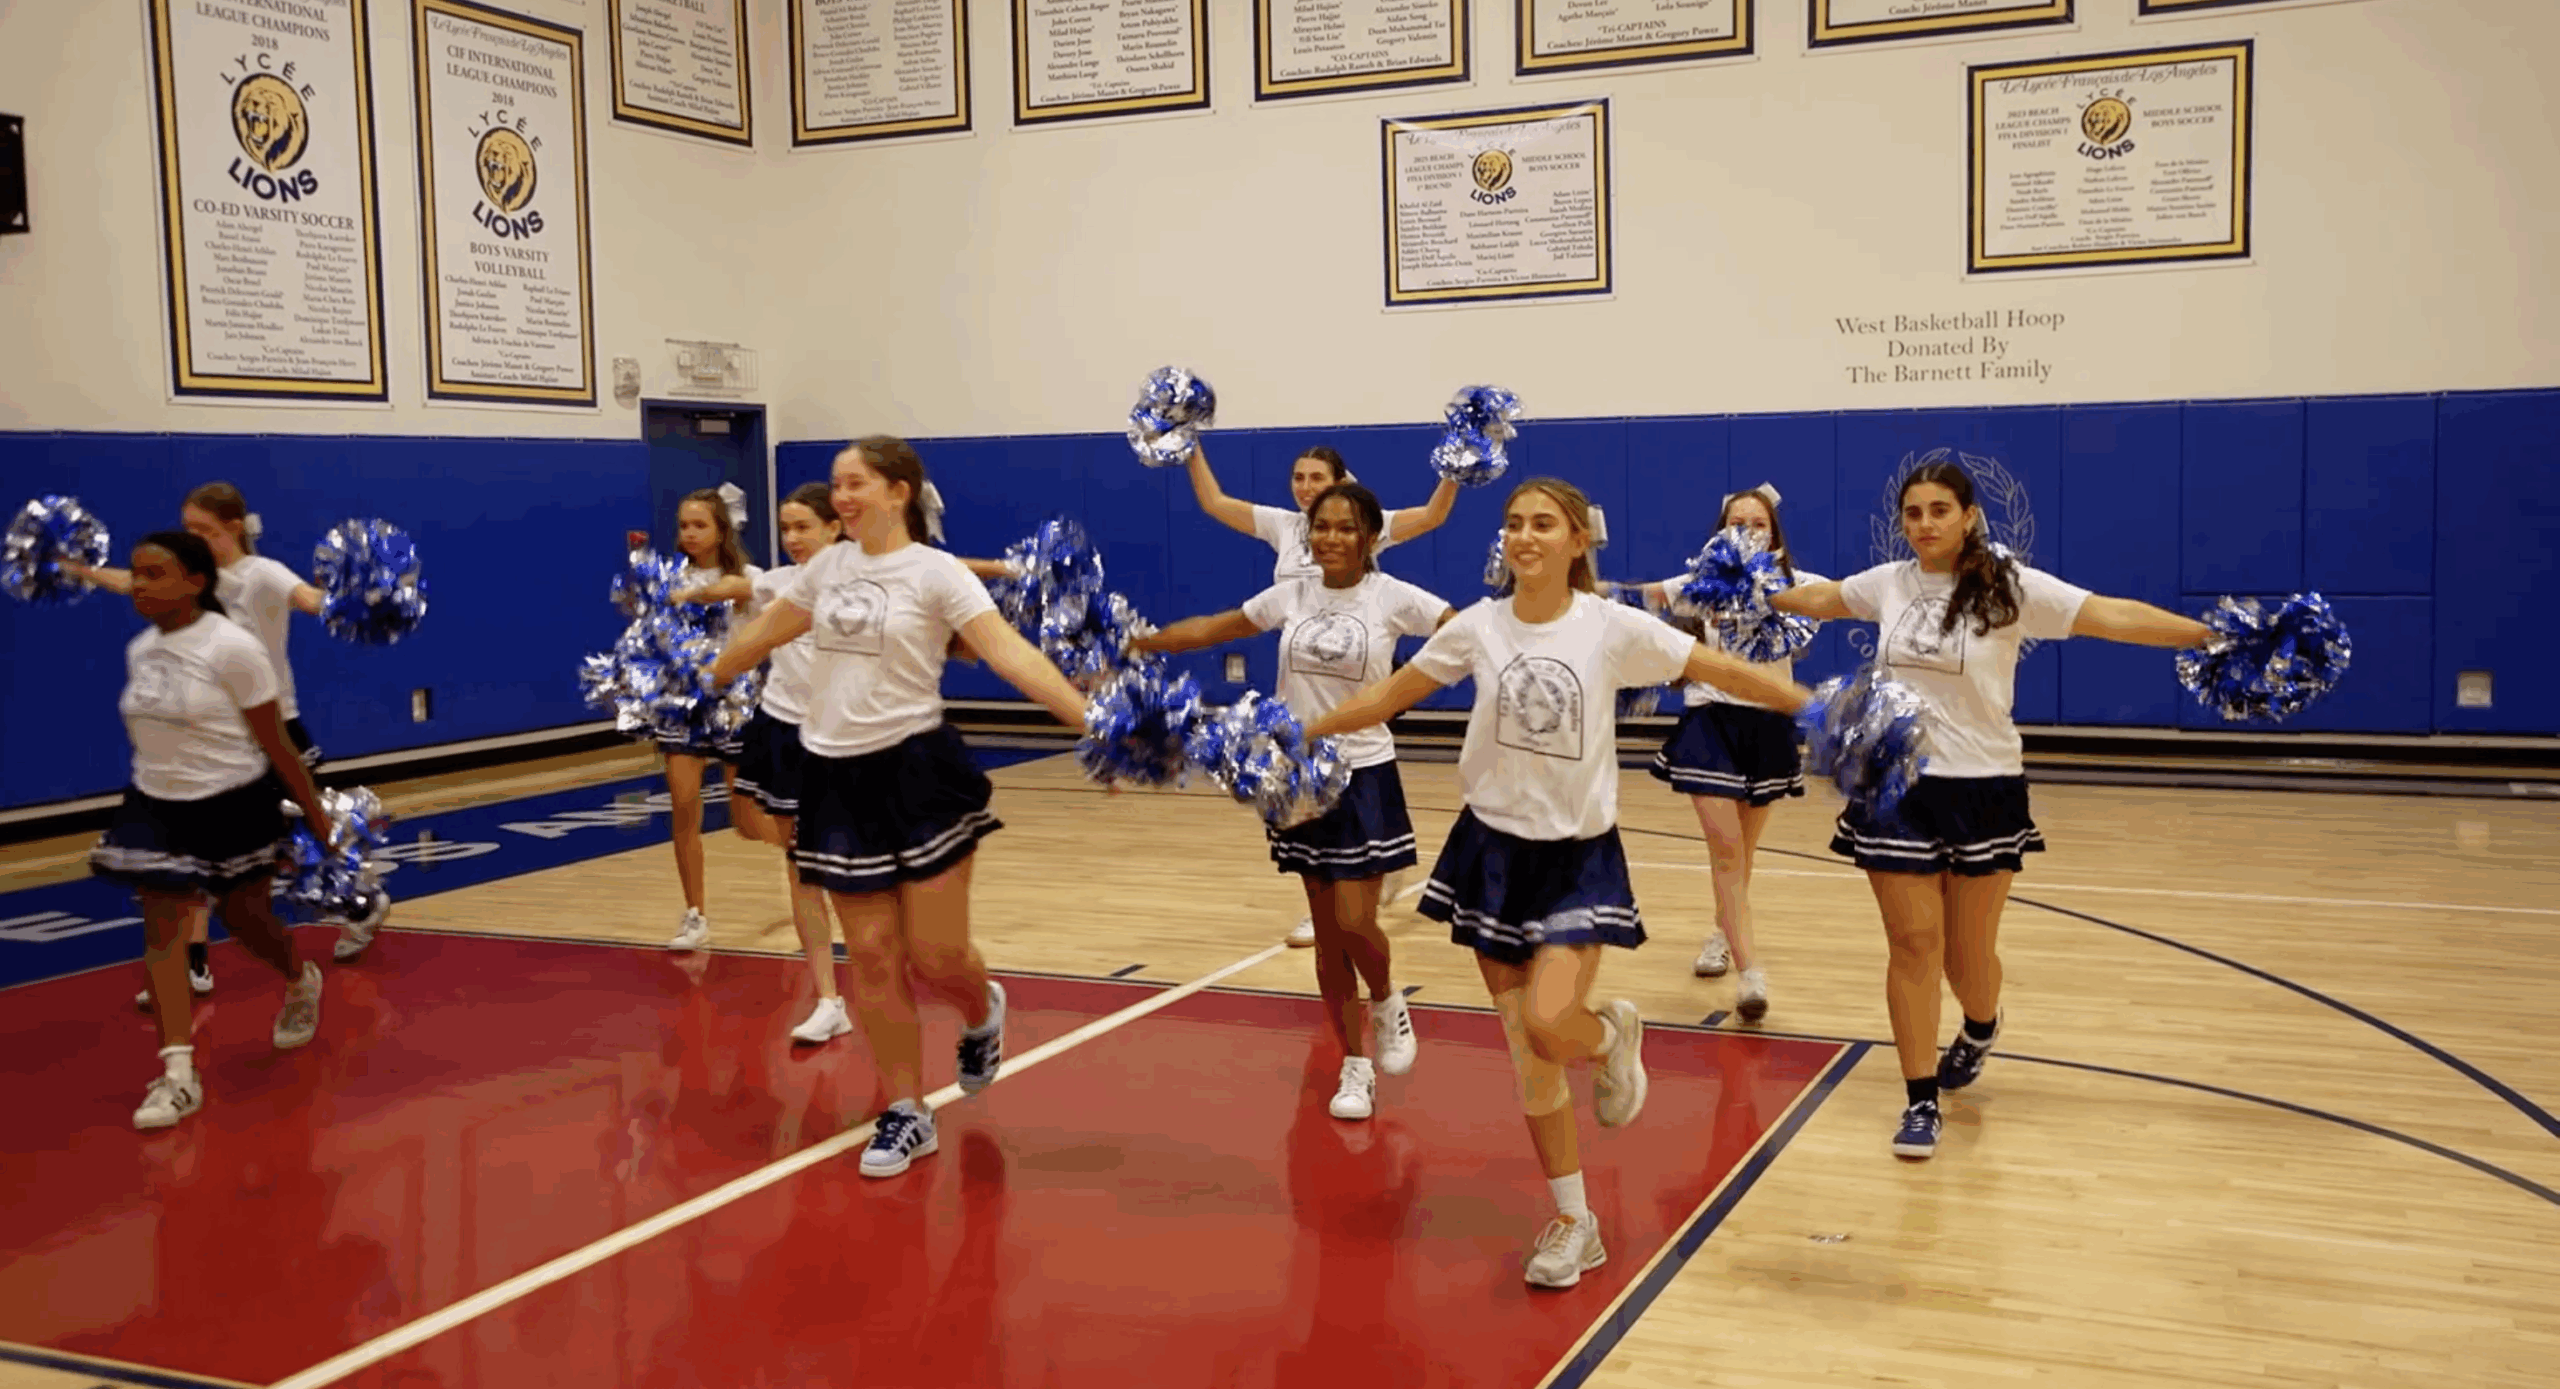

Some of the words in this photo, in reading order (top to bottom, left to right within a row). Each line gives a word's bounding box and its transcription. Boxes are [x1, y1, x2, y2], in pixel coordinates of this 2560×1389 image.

[196, 2, 249, 26] LEAGUE
[251, 13, 331, 42] CHAMPIONS
[251, 33, 280, 51] 2018
[1644, 32, 1654, 41] &
[446, 44, 467, 59] CIF
[467, 49, 556, 81] INTERNATIONAL
[1376, 60, 1385, 70] &
[219, 53, 316, 102] LYCÉE
[446, 62, 491, 84] LEAGUE
[491, 73, 558, 99] CHAMPIONS
[491, 91, 515, 107] 2018
[2076, 87, 2138, 110] LYCÉE
[2028, 106, 2060, 118] BEACH
[2142, 107, 2181, 119] MIDDLE
[2181, 103, 2224, 116] SCHOOL
[2151, 118, 2176, 129] BOYS
[2176, 114, 2216, 126] SOCCER
[467, 109, 543, 152] LYCÉE
[1995, 119, 2031, 131] LEAGUE
[2031, 116, 2072, 129] CHAMPS
[2019, 128, 2062, 140] DIVISION
[2012, 139, 2052, 151] FINALIST
[2076, 138, 2136, 161] LIONS
[1404, 164, 1432, 175] LEAGUE
[1432, 161, 1465, 172] CHAMPS
[1521, 154, 1554, 165] MIDDLE
[1554, 151, 1587, 163] SCHOOL
[1528, 164, 1549, 174] BOYS
[1549, 162, 1581, 173] SOCCER
[227, 157, 318, 203] LIONS
[1470, 185, 1517, 206] LIONS
[193, 198, 241, 216] CO-ED
[242, 204, 301, 225] VARSITY
[301, 212, 355, 231] SOCCER
[472, 199, 544, 241] LIONS
[470, 241, 501, 257] BOYS
[502, 245, 550, 263] VARSITY
[474, 260, 546, 281] VOLLEYBALL
[1835, 317, 1887, 335] West
[1894, 310, 1999, 333] Basketball
[2007, 308, 2066, 332] Hoop
[1887, 335, 1975, 359] Donated
[1982, 334, 2011, 361] By
[1845, 366, 1887, 384] The
[1894, 363, 1973, 384] Barnett
[1980, 357, 2053, 385] Family
